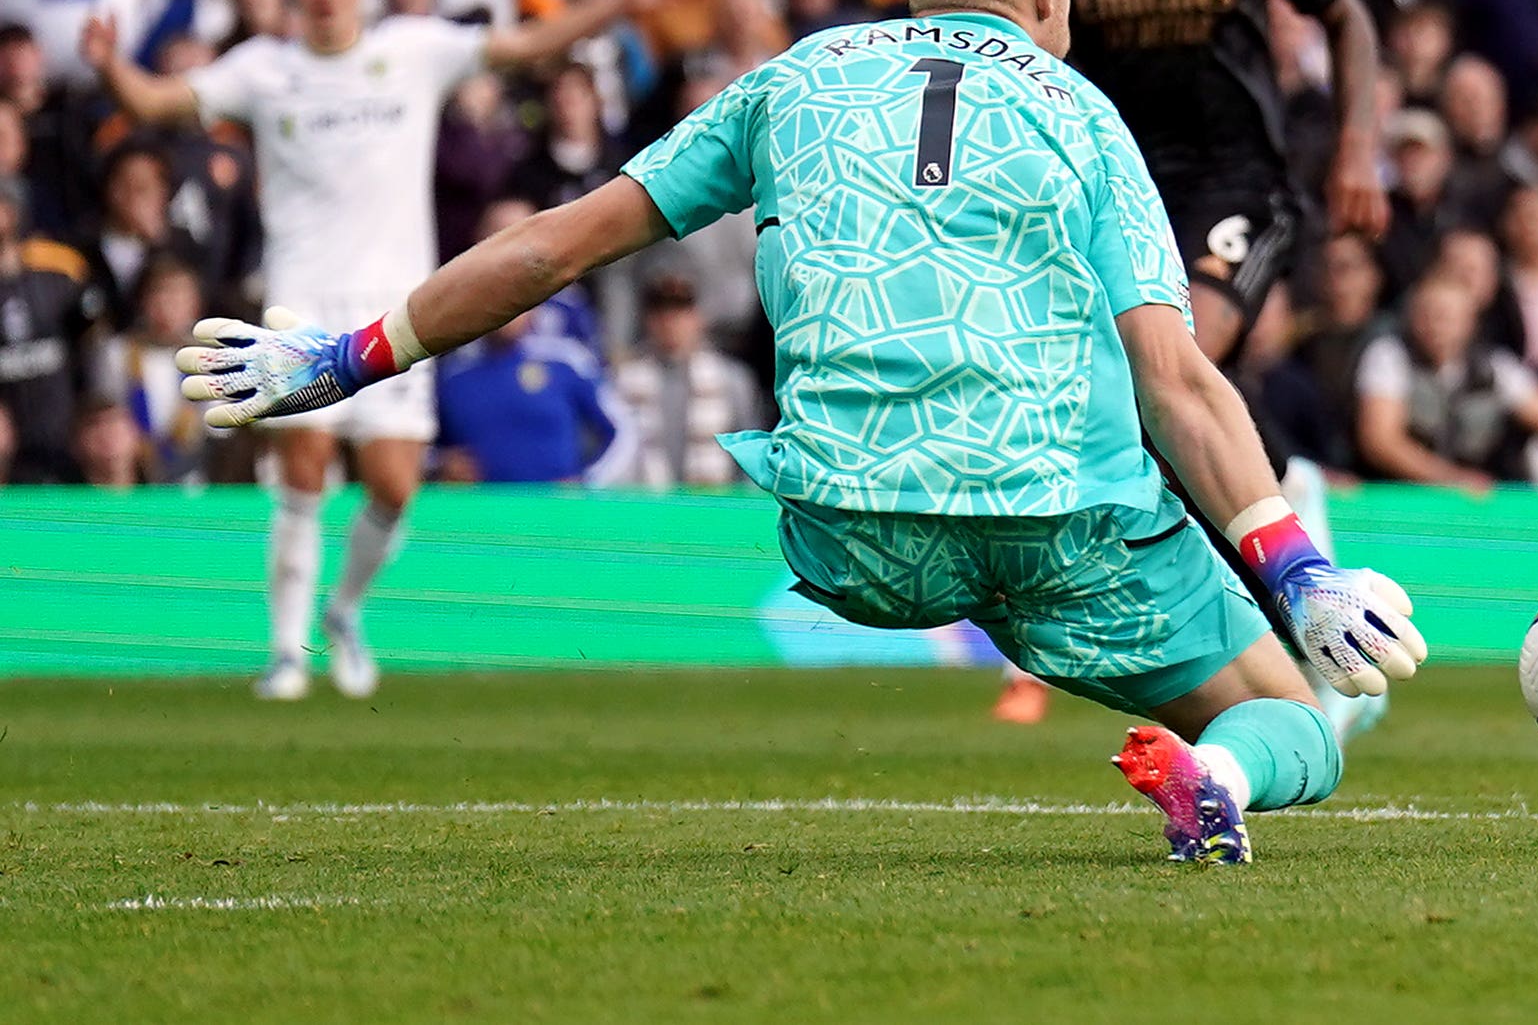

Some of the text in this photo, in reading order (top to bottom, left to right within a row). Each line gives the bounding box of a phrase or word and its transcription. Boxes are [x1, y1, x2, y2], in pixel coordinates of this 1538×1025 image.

[823, 26, 1076, 108] RAMSDALE
[908, 57, 967, 187] 1
[1206, 214, 1251, 264] 6
